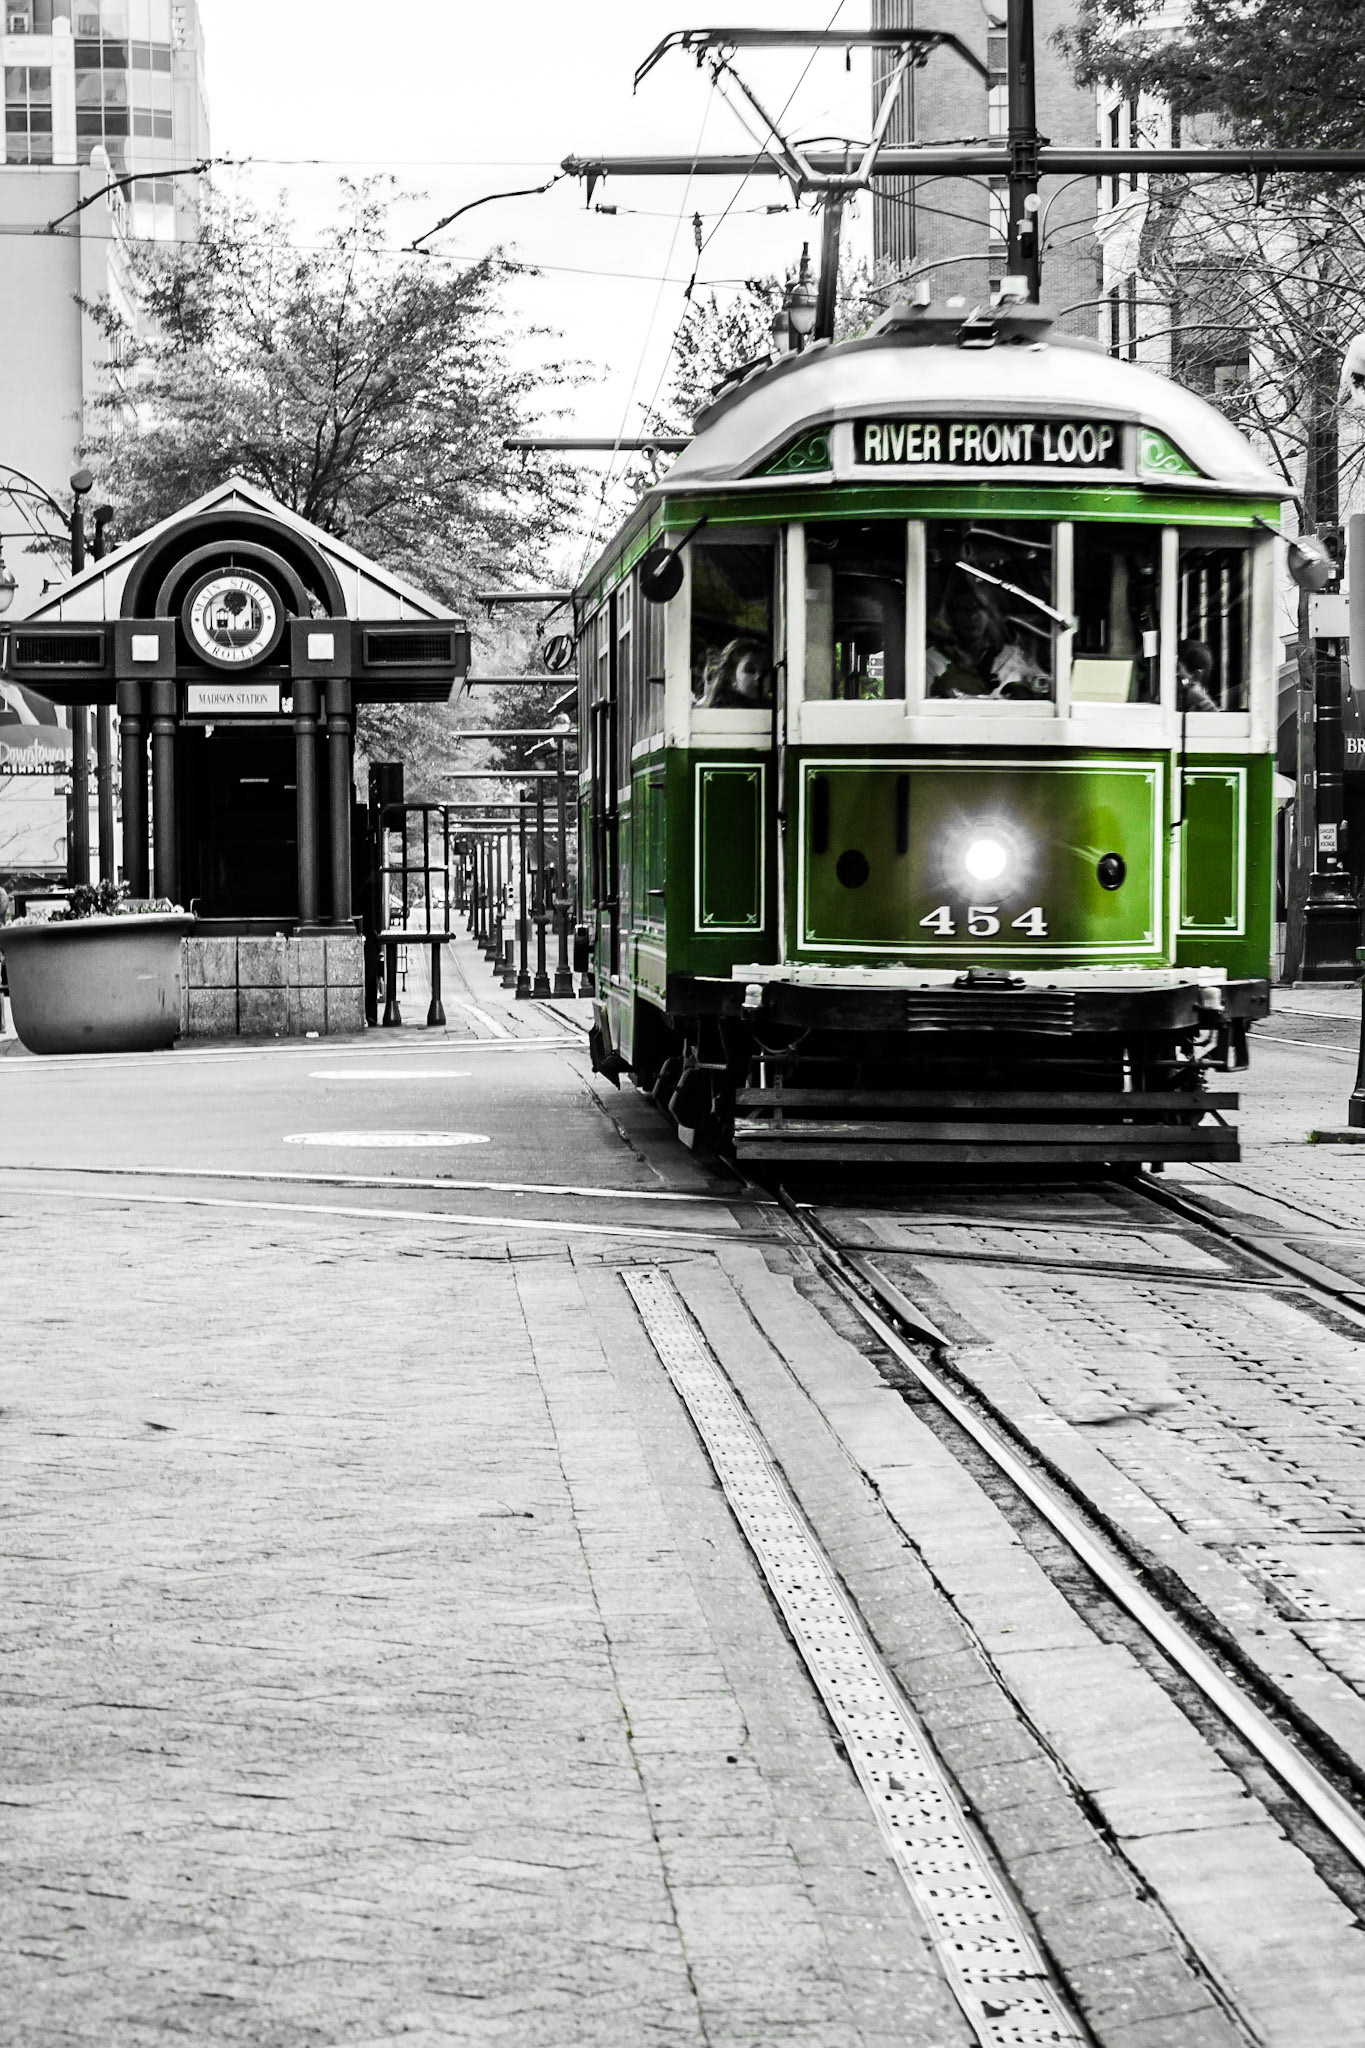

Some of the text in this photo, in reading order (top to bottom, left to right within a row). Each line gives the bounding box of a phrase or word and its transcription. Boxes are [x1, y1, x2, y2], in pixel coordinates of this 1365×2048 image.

[864, 423, 1113, 463] RIVER FRONT LOOP
[194, 579, 271, 612] MAIN STREET
[204, 640, 265, 660] TROLLEY
[199, 693, 268, 705] MADISON STATION
[1346, 737, 1365, 754] BR
[918, 905, 1049, 937] 454
